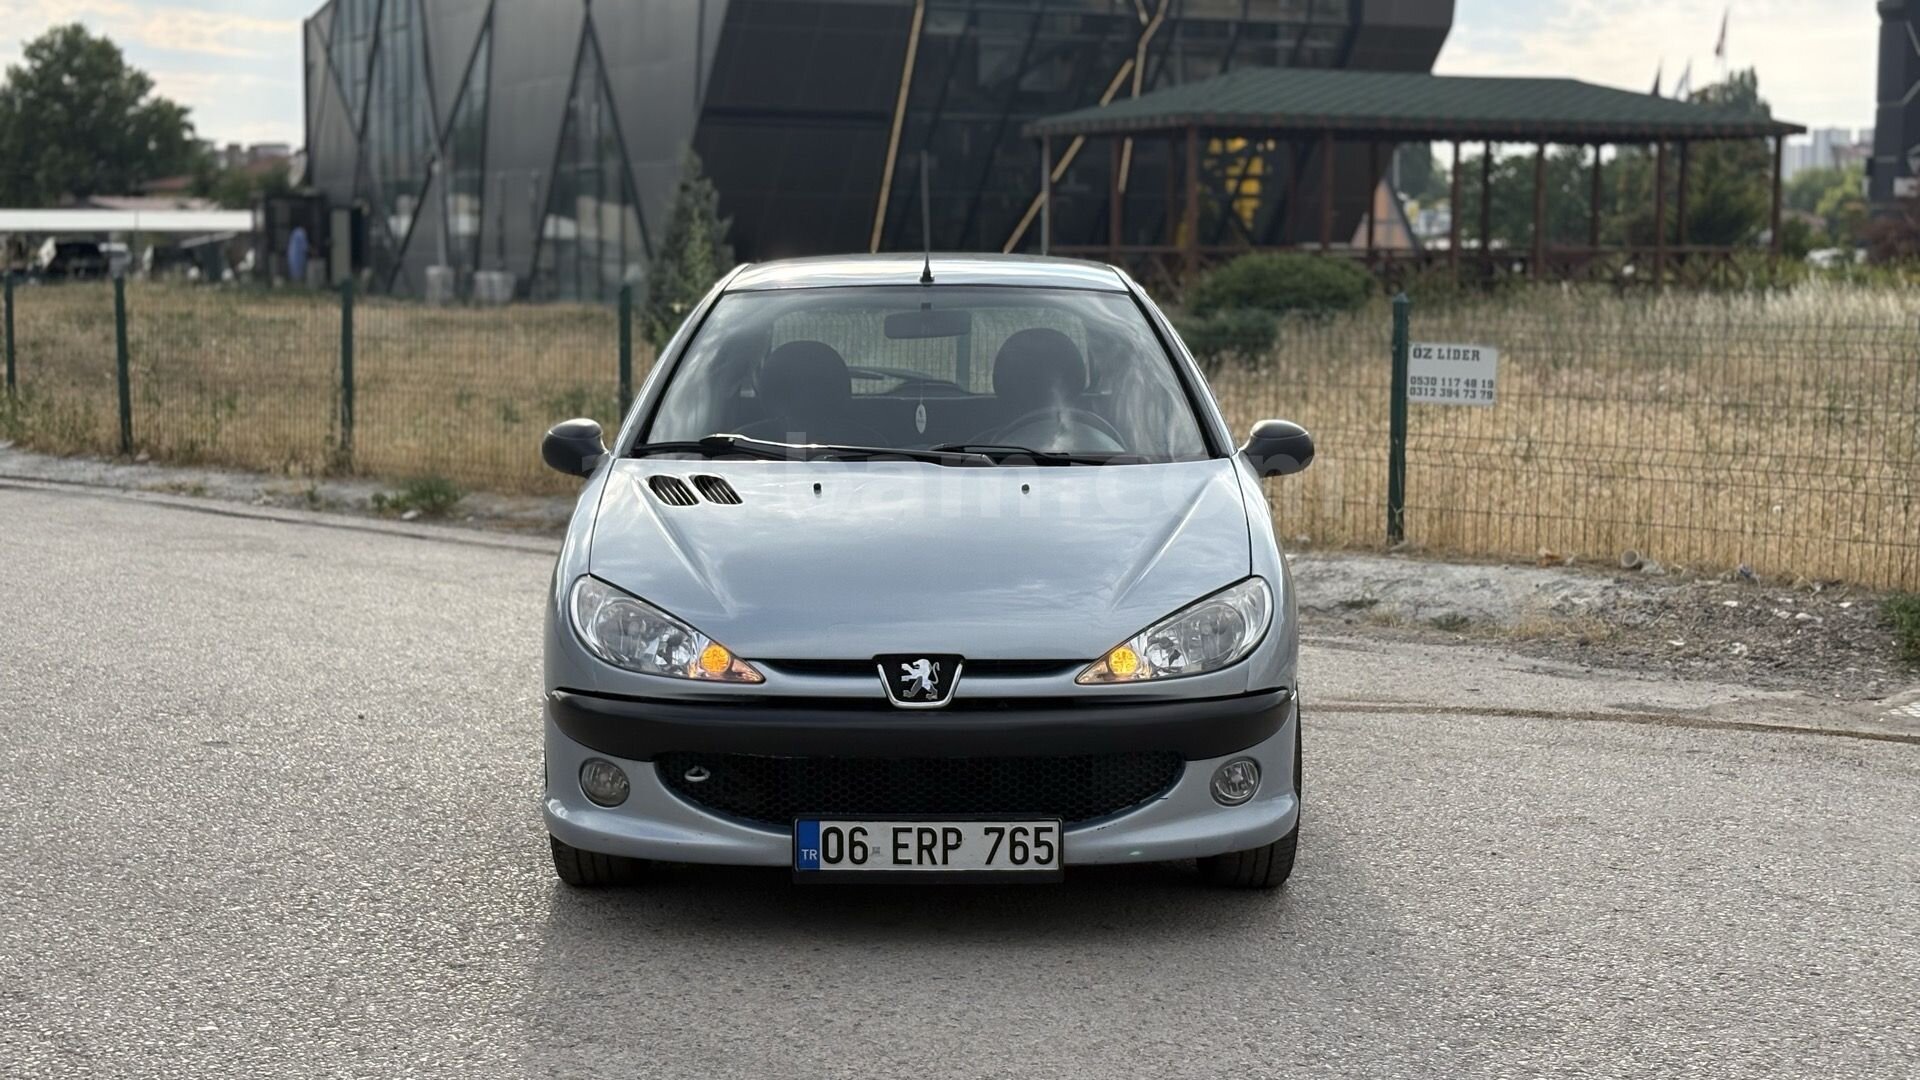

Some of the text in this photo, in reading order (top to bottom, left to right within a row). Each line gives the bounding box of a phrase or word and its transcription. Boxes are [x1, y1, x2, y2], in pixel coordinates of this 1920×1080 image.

[1412, 344, 1433, 360] ÖZ
[1410, 376, 1437, 386] 0530
[1441, 377, 1461, 387] 117
[1481, 379, 1494, 389] 19
[1409, 387, 1437, 397] 0312
[1439, 388, 1460, 398] 394
[1463, 389, 1477, 399] 73
[801, 826, 1054, 865] TR 06 ERP 765
